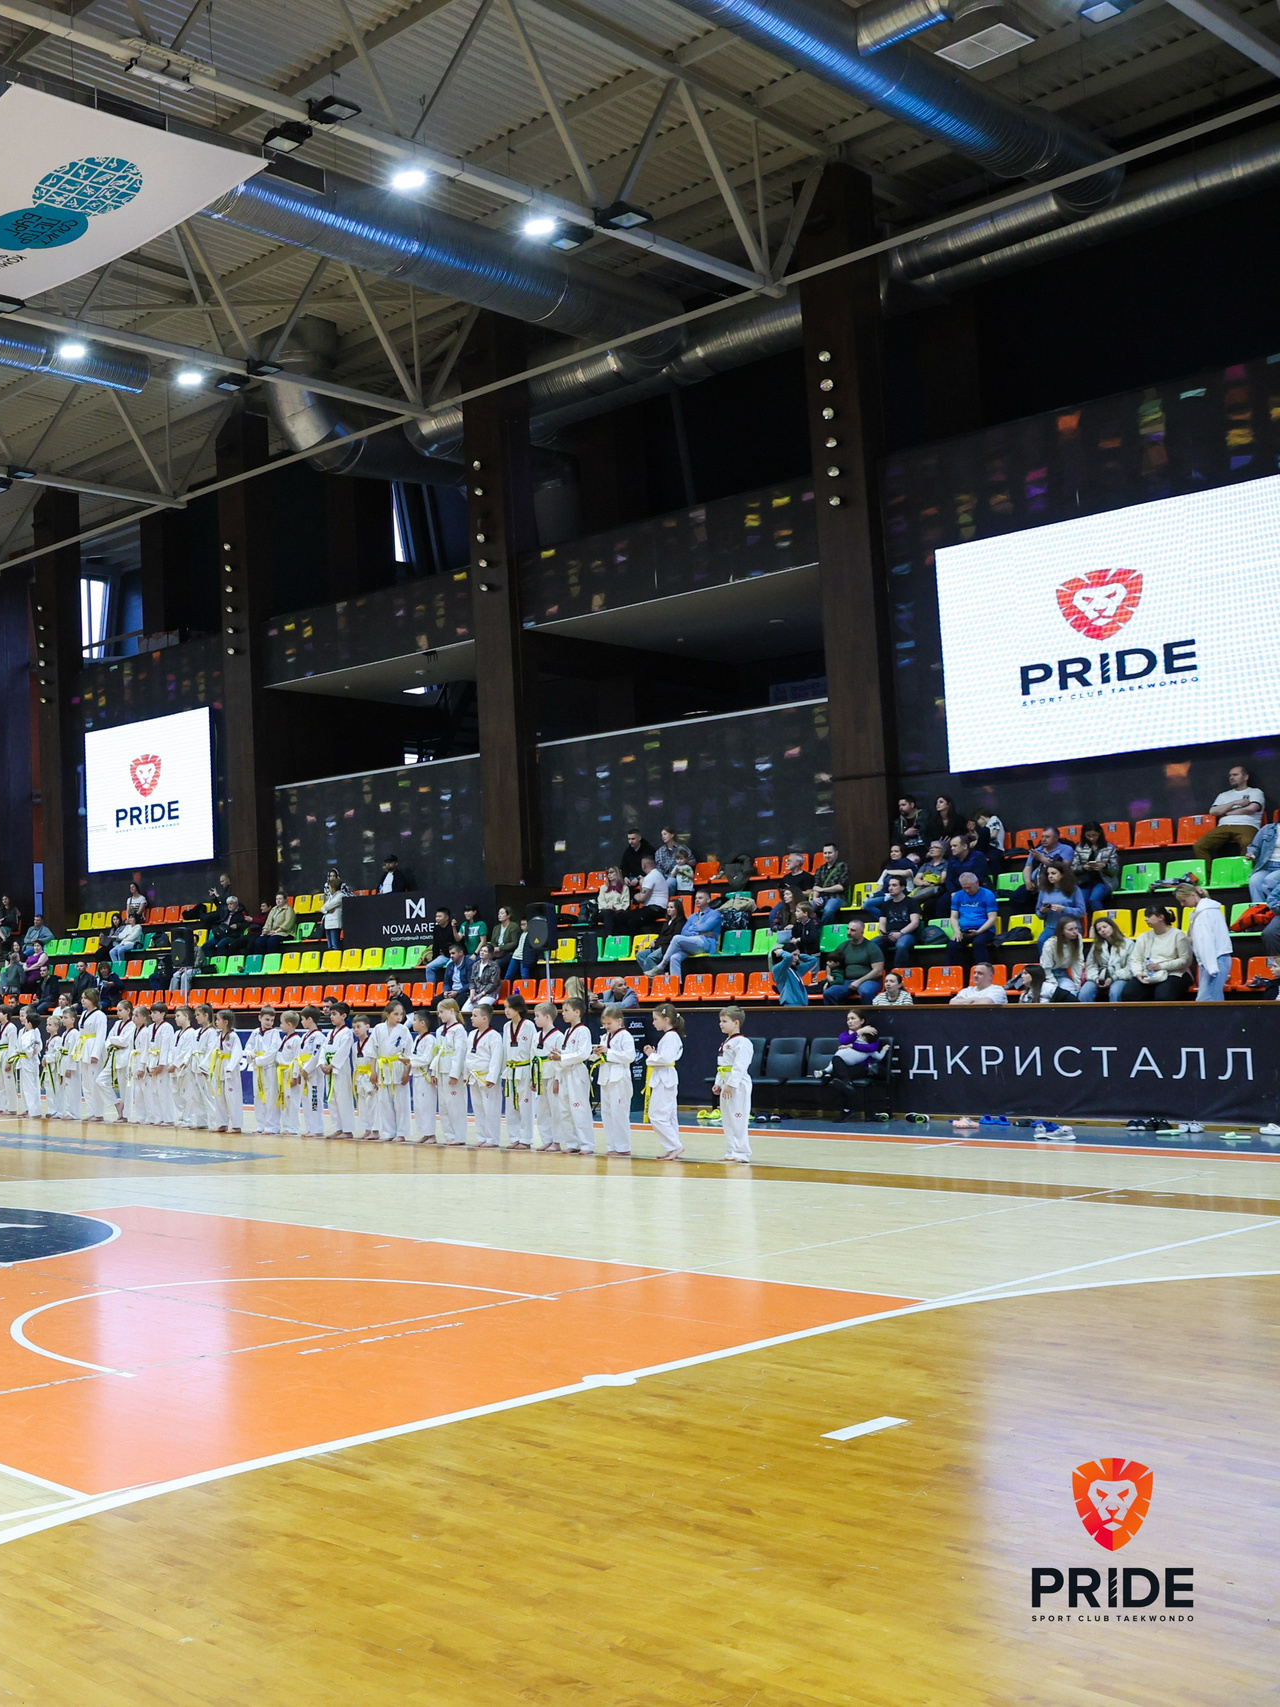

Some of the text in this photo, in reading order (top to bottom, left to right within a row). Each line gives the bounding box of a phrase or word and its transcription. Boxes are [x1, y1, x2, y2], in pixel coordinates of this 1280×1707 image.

[1020, 638, 1198, 696] PRIDE
[1022, 677, 1199, 707] SPORT CLUB TAEKWONDO
[115, 800, 180, 828] PRIDE
[382, 922, 434, 935] NOVA ARE
